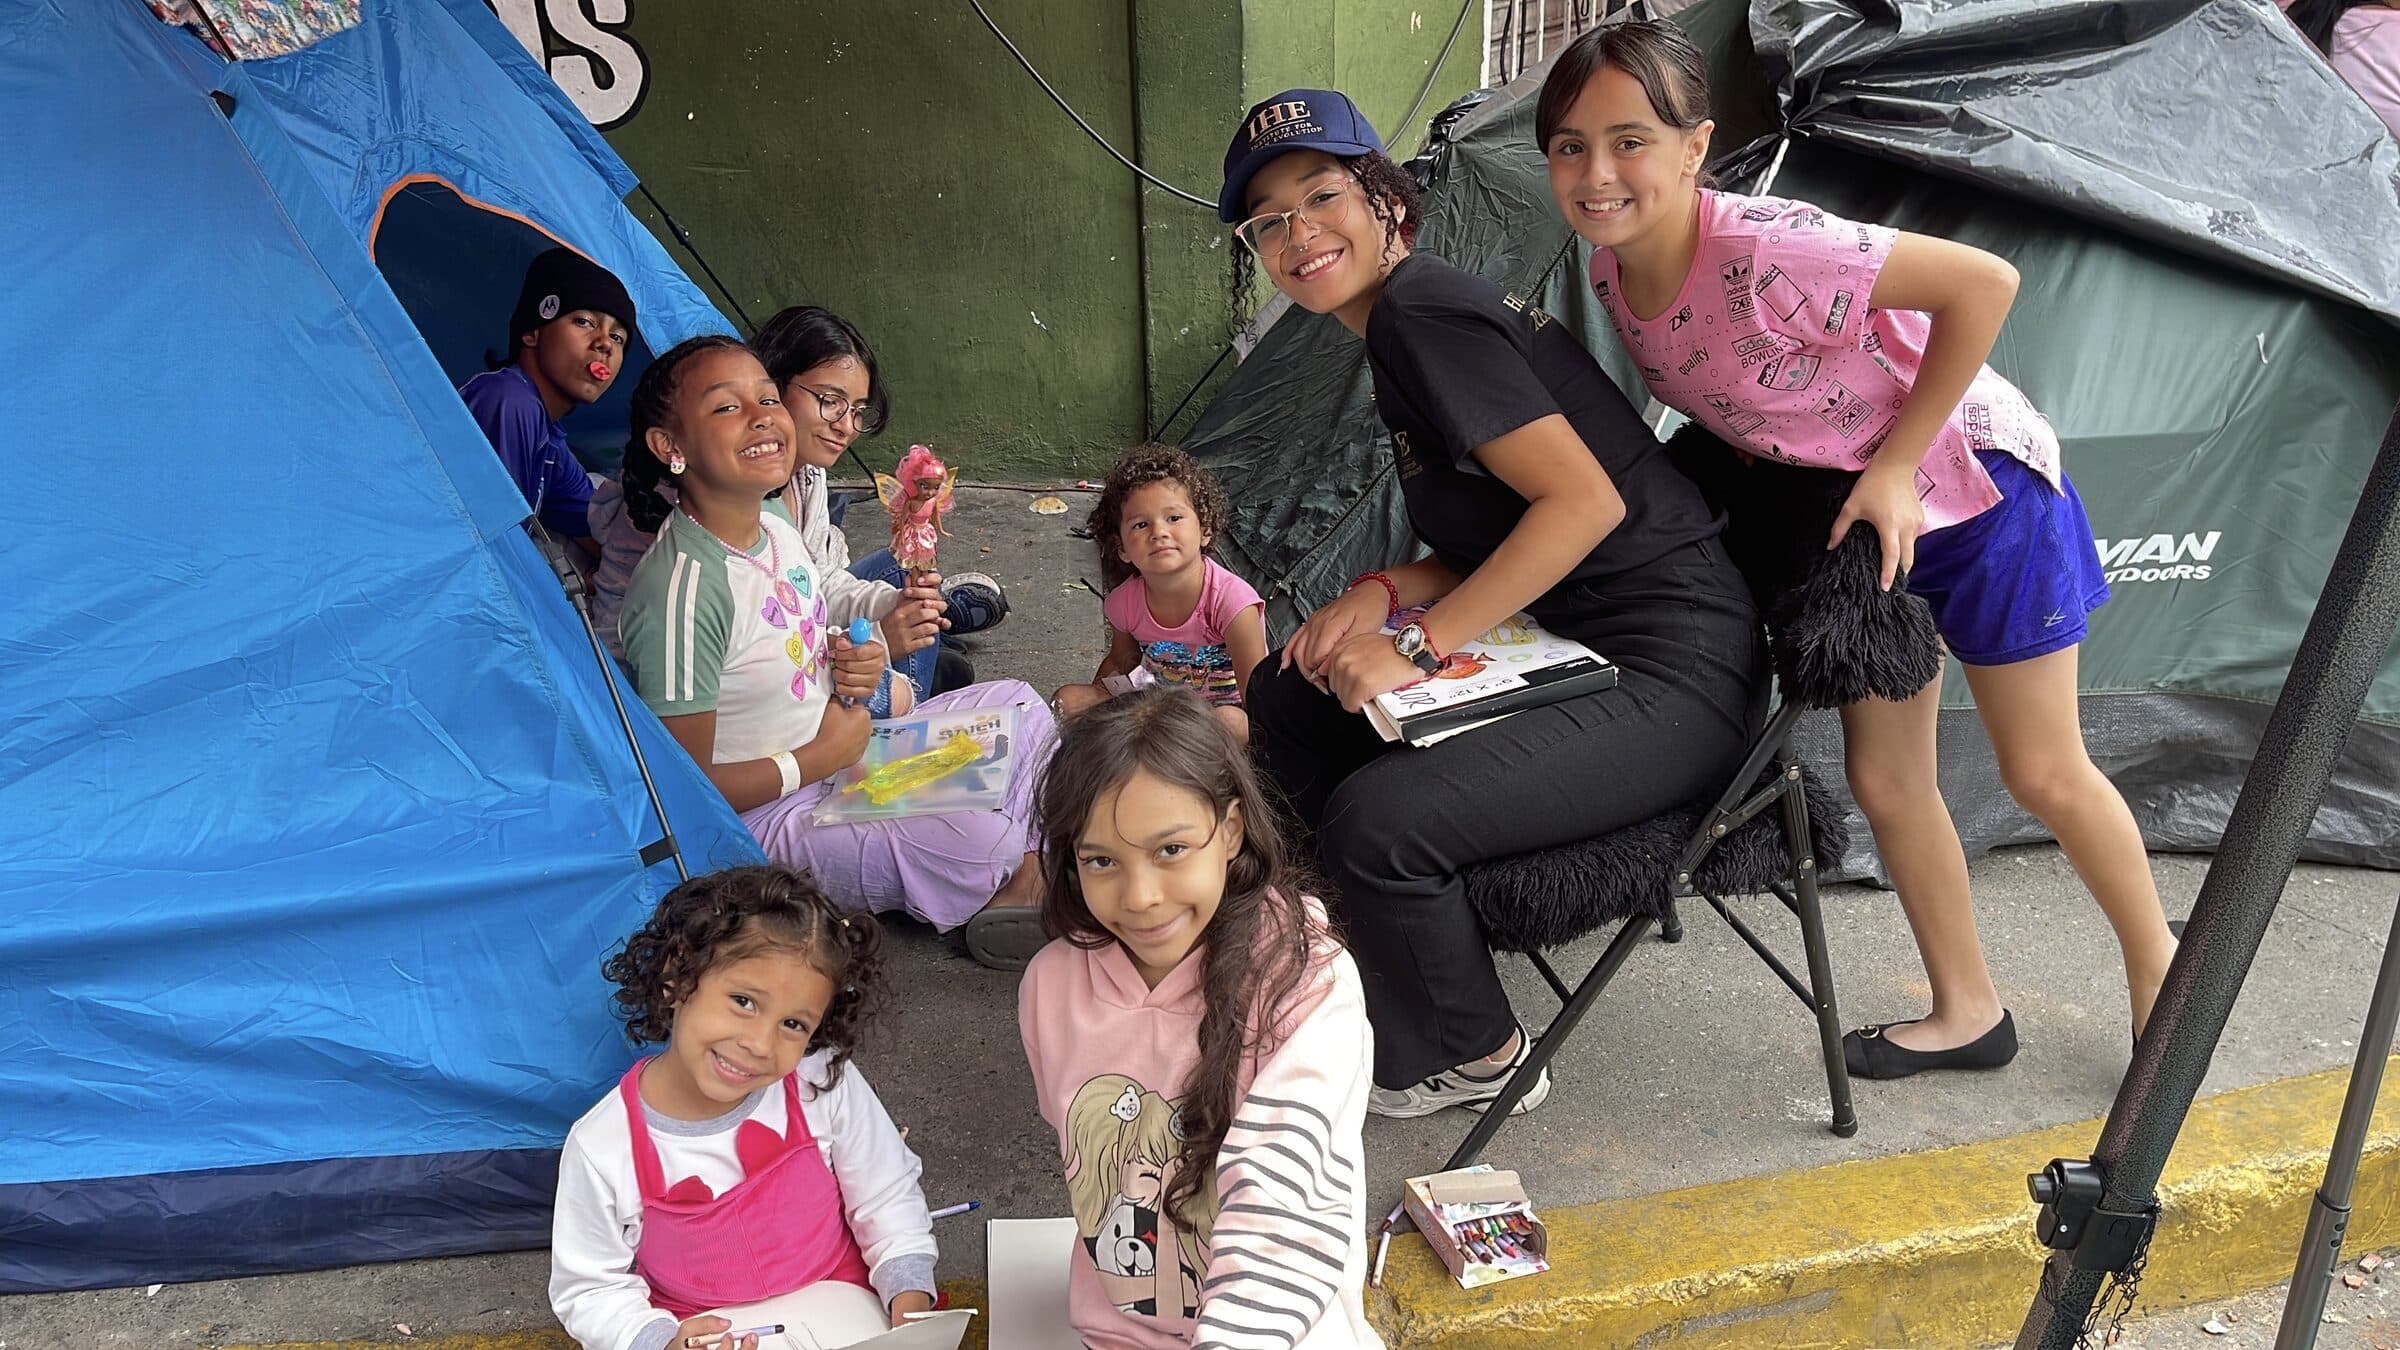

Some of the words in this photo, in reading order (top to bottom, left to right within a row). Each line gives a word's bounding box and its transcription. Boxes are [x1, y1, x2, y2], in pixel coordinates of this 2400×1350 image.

[1248, 101, 1311, 142] IHE
[1737, 334, 1776, 354] adida
[1678, 346, 1710, 376] quality
[2094, 531, 2222, 568] MAN
[2104, 564, 2212, 585] TDOORS
